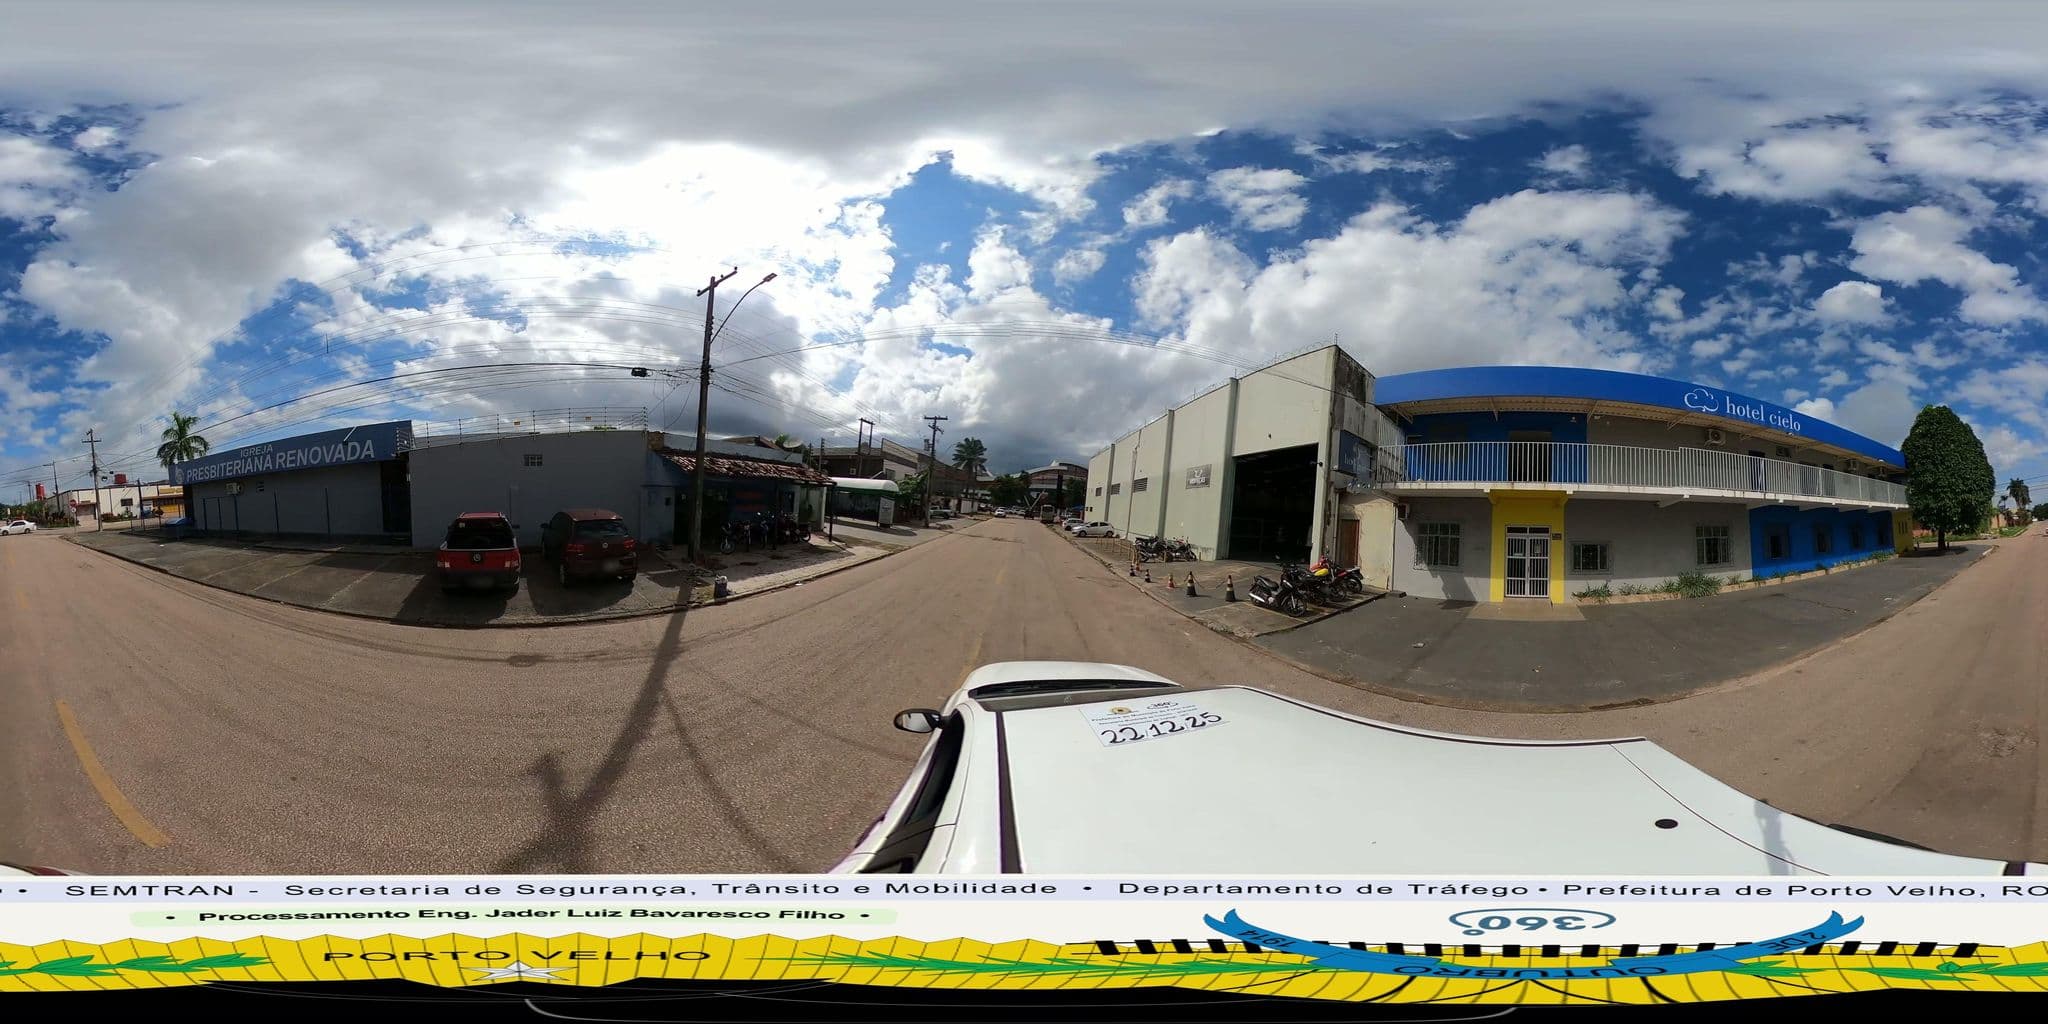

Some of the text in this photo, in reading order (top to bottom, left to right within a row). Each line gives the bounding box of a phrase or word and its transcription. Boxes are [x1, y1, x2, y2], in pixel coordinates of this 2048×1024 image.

[1726, 396, 1801, 431] hotel cielo
[186, 440, 376, 483] PRESBITERIANA RENOVADA
[240, 444, 273, 457] IGREJA
